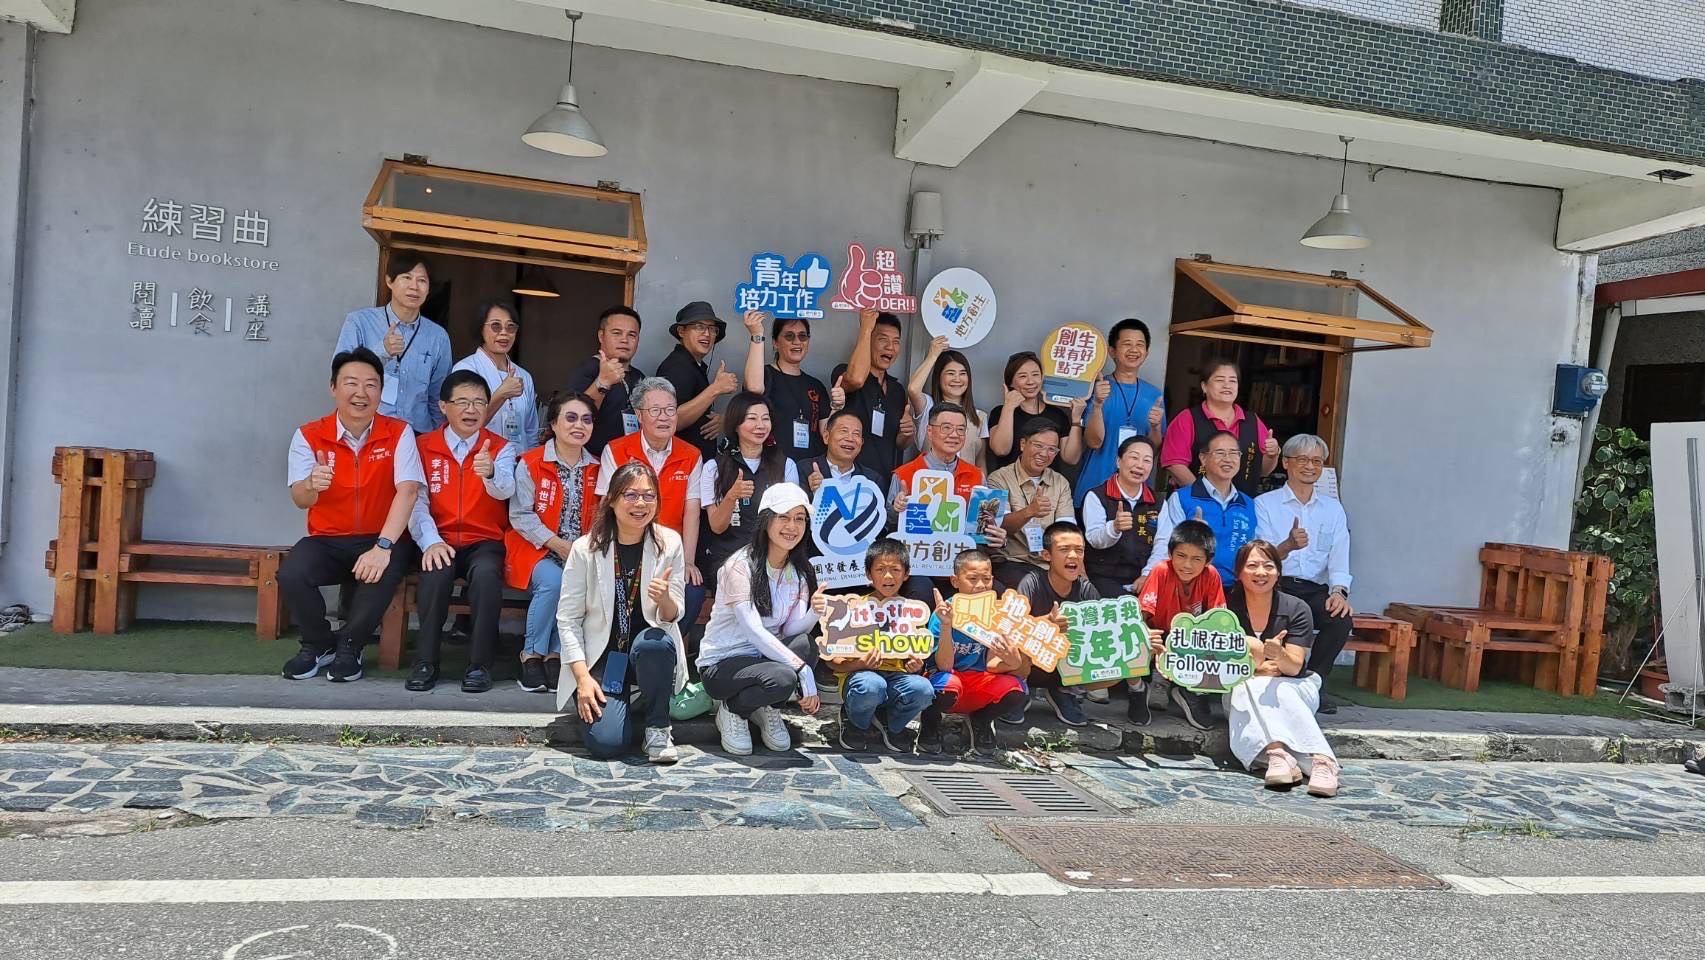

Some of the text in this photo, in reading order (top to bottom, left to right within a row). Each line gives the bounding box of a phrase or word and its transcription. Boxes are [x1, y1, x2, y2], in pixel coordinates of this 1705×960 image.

[142, 198, 270, 247] 練習曲
[127, 241, 280, 271] Etude bookstore
[755, 257, 799, 291] 青年
[129, 281, 157, 330] 閱讀
[187, 286, 214, 336] 飲食
[739, 288, 815, 314] 培力工作
[880, 297, 915, 311] DER!!
[244, 294, 271, 342] 講座
[955, 293, 987, 338] 地方創生
[1058, 328, 1096, 349] 創生
[1053, 345, 1094, 362] 我有好
[1057, 361, 1085, 376] 點子
[902, 539, 970, 562] 方創生
[814, 559, 865, 575] 國家發展
[888, 620, 909, 633] to
[1000, 595, 1066, 654] 地方創生
[1062, 601, 1140, 628] 台灣有我
[856, 628, 932, 653] show
[1172, 628, 1245, 652] 扎根在地
[1165, 654, 1249, 676] Follow me
